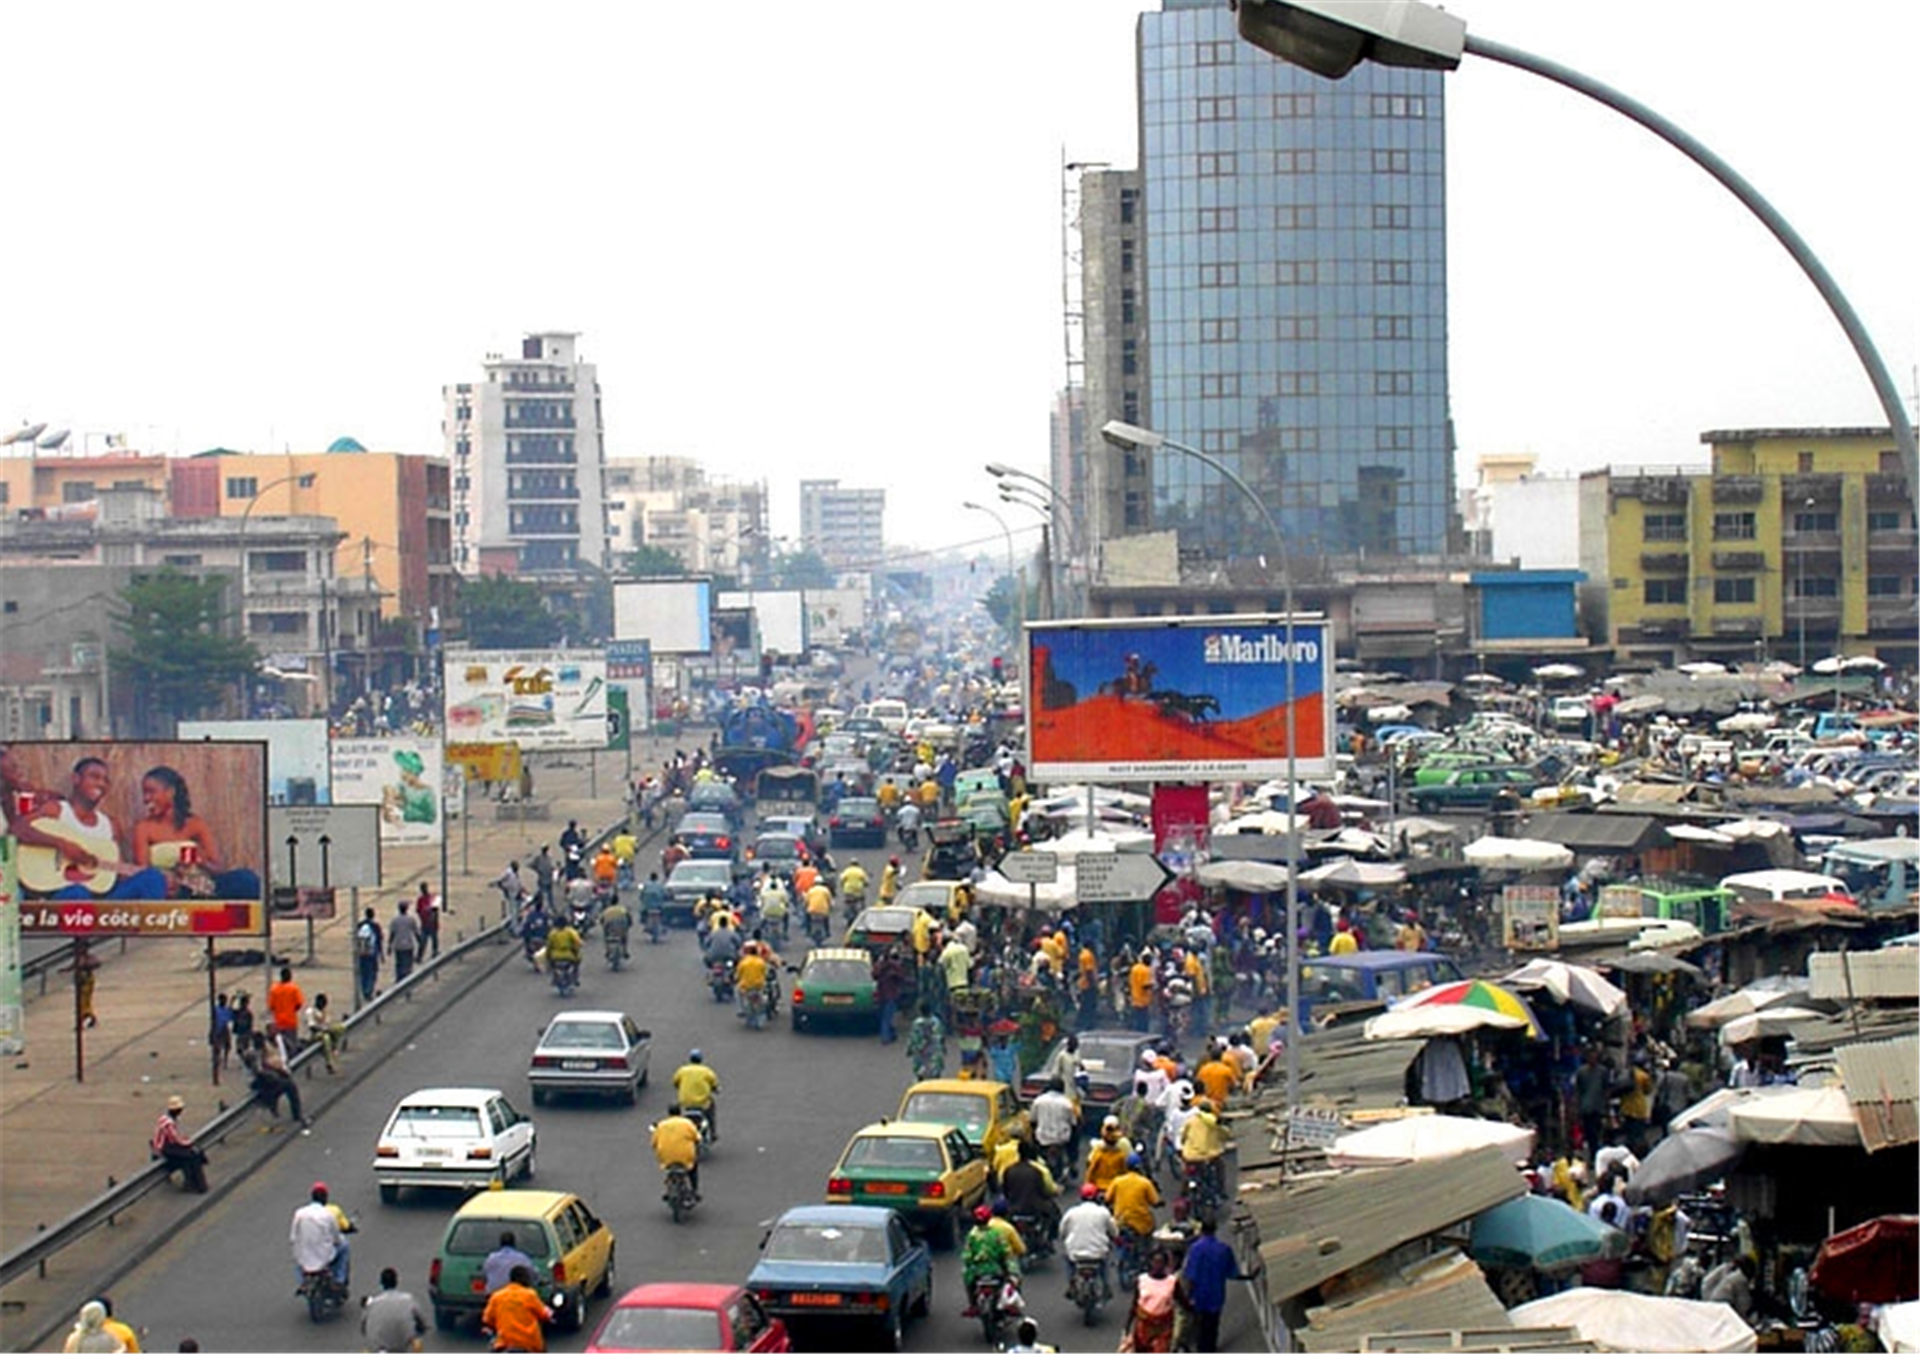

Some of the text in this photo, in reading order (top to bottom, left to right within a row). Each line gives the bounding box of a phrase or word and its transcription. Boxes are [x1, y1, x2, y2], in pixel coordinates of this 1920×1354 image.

[1221, 634, 1318, 662] Marlboro
[40, 908, 58, 927] la
[63, 907, 94, 927] vie
[145, 906, 190, 930] café
